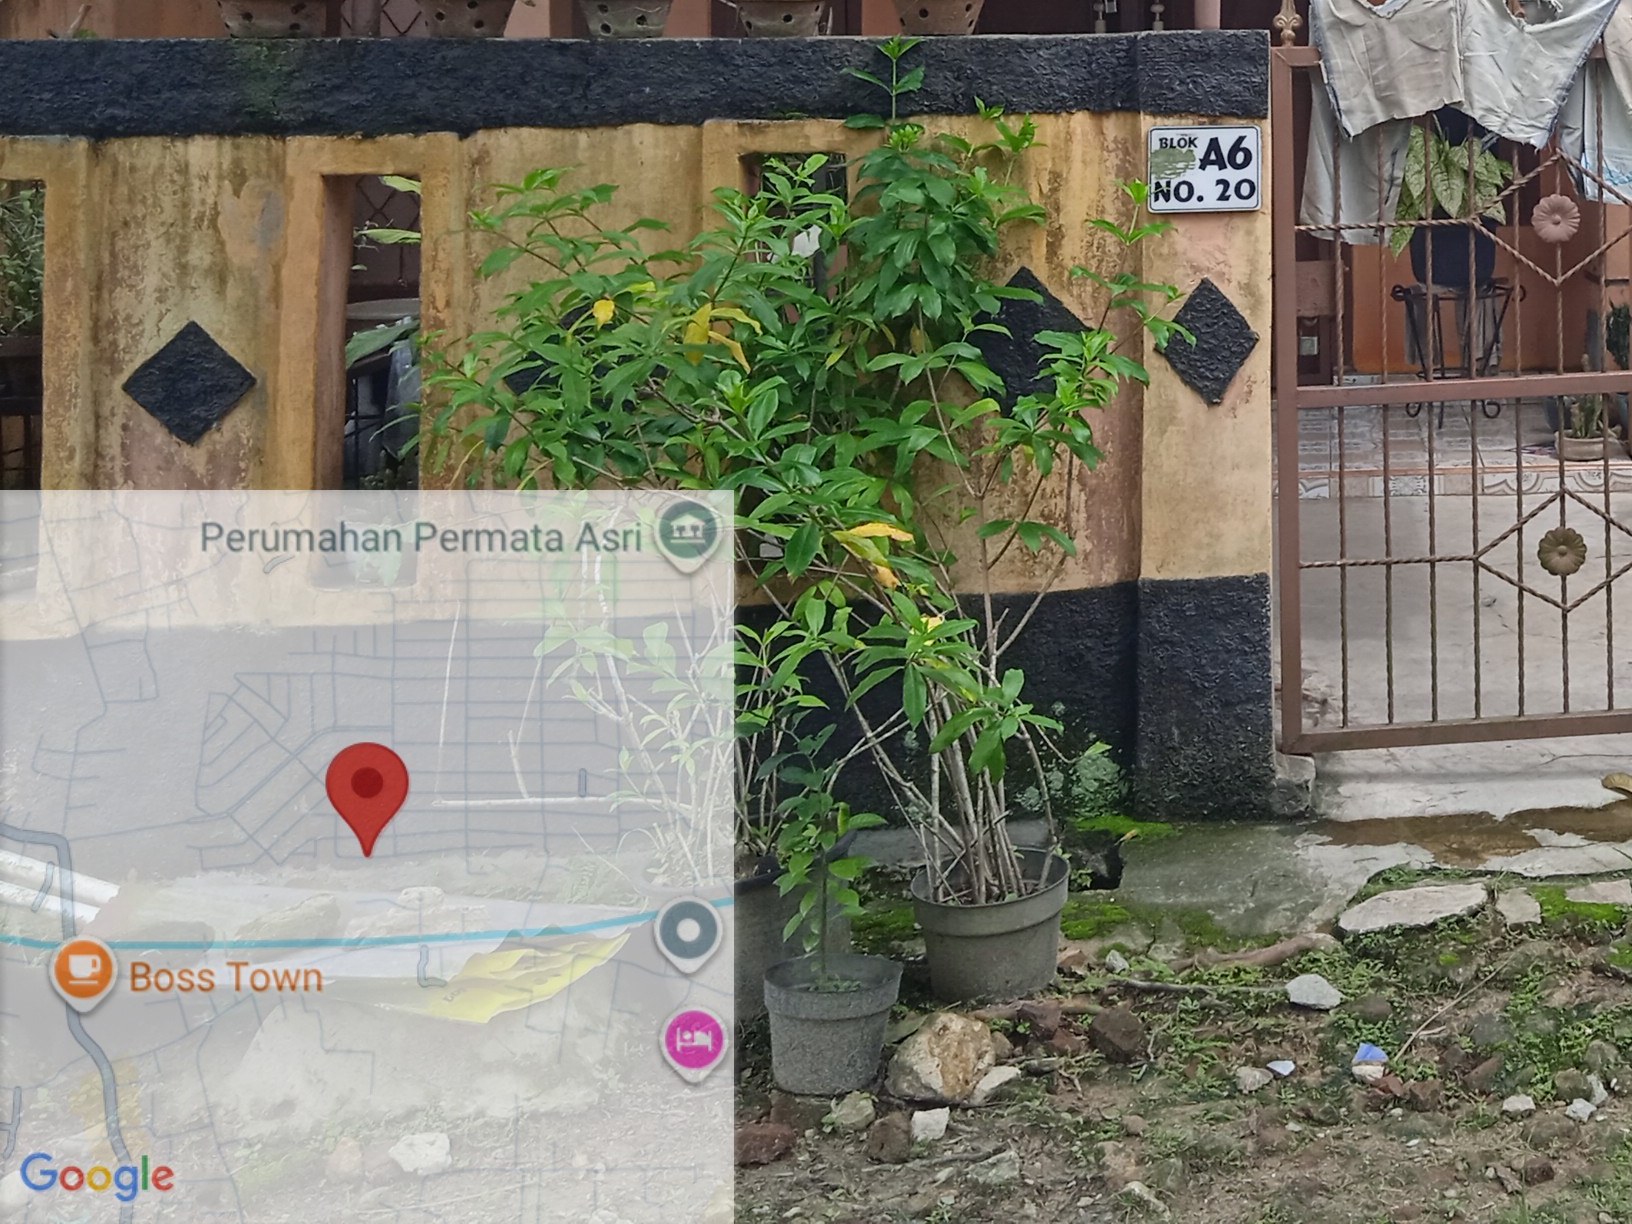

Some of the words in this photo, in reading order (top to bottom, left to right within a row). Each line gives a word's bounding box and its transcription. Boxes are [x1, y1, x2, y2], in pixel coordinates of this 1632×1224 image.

[1159, 136, 1199, 149] BLOK
[1198, 135, 1253, 171] A6
[1153, 180, 1204, 203] NO.
[1215, 178, 1256, 201] 20
